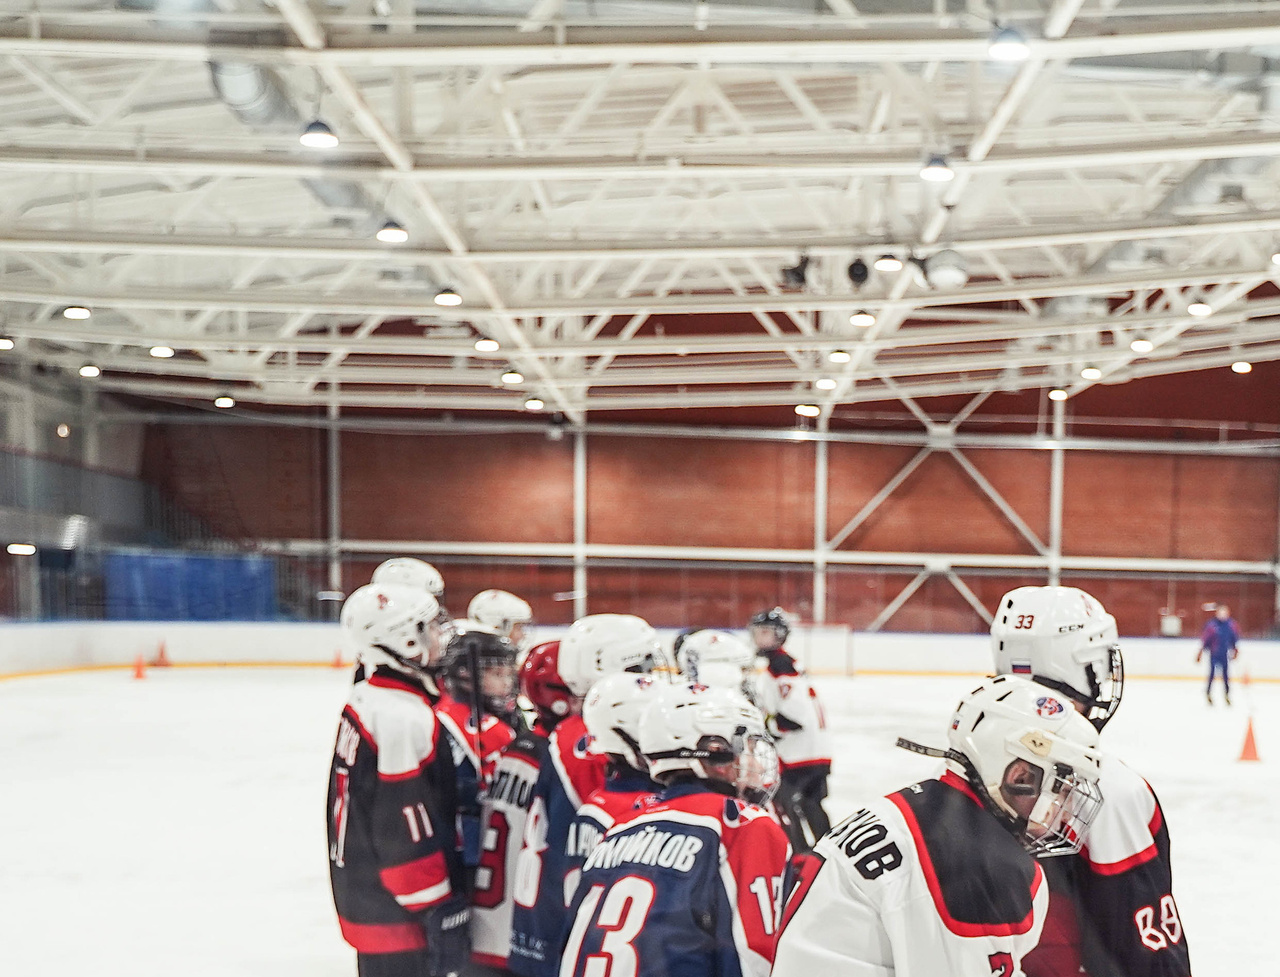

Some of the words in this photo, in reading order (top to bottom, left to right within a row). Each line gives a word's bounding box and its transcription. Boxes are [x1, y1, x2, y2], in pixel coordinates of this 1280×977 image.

[1013, 614, 1035, 630] 33
[402, 801, 434, 843] 11
[1133, 893, 1182, 952] 88
